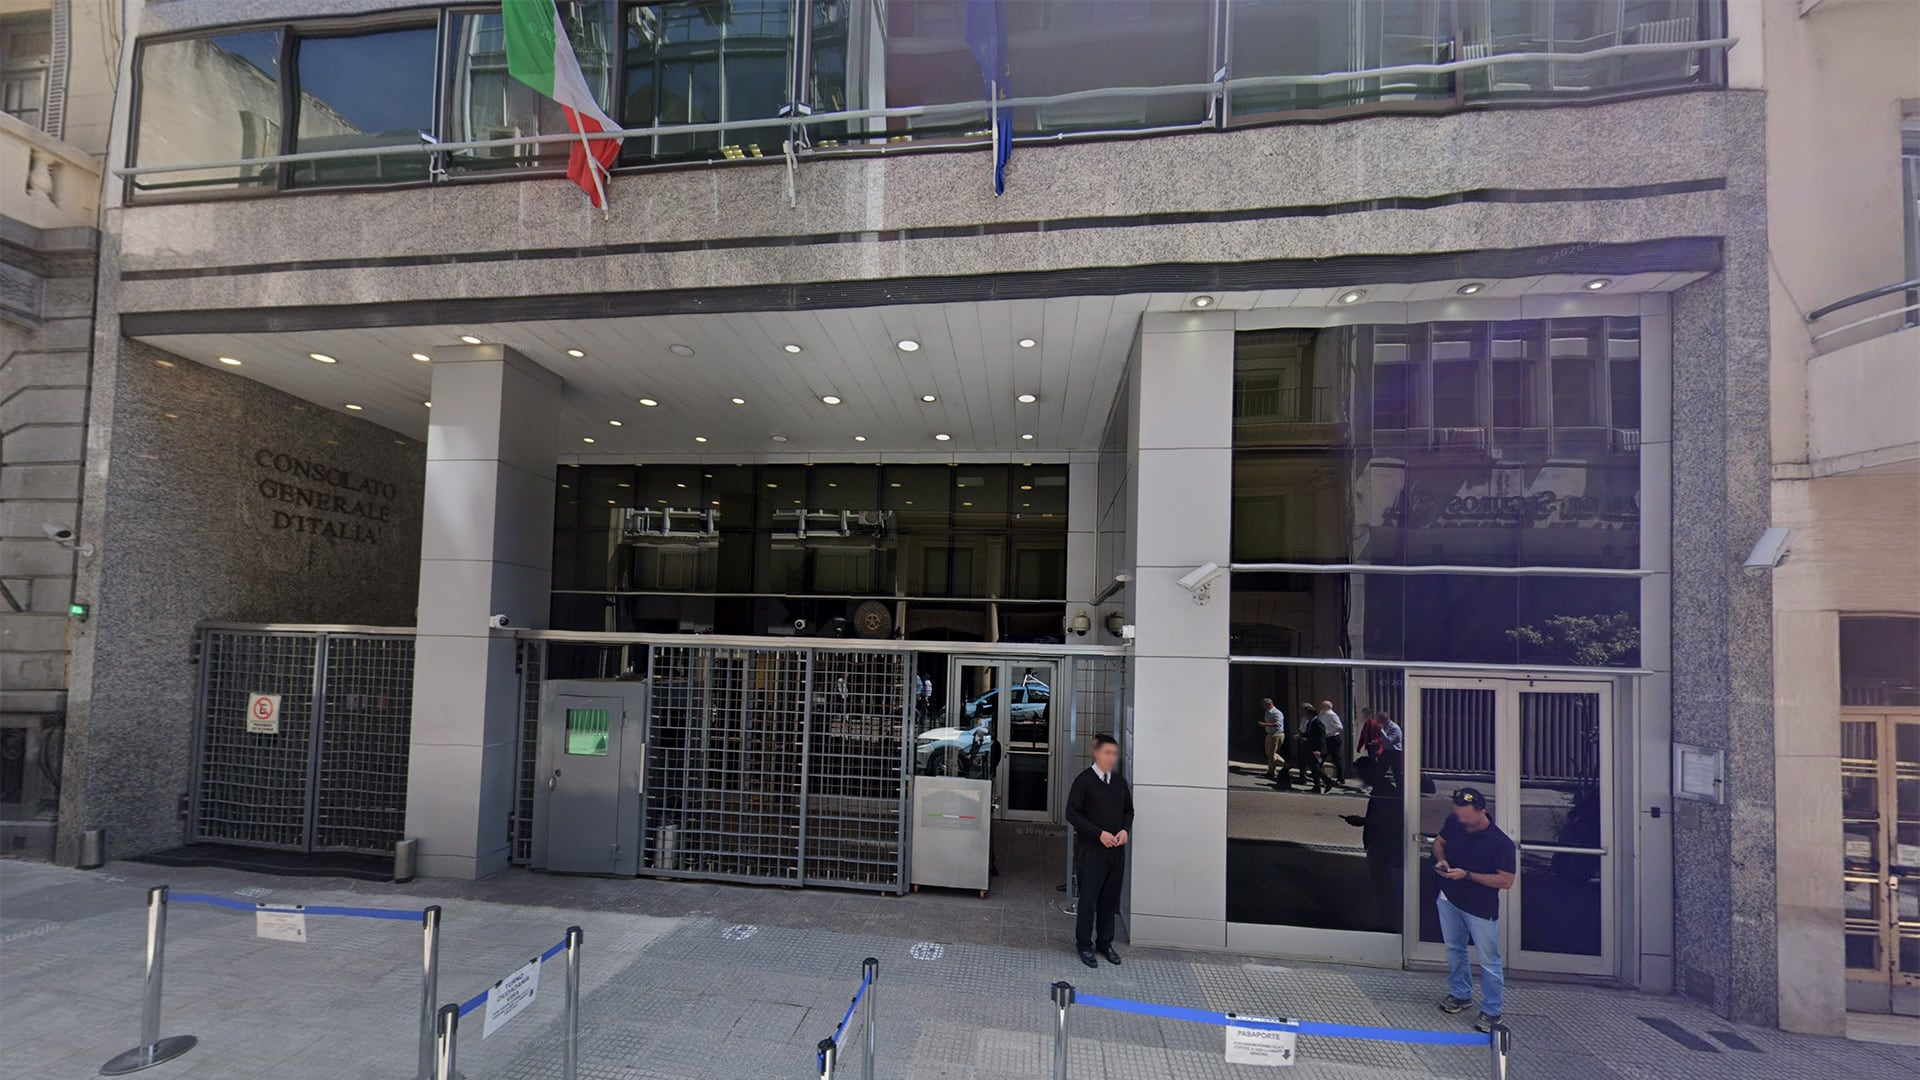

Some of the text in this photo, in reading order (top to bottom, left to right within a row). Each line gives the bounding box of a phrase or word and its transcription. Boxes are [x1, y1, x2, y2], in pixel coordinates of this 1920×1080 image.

[255, 449, 397, 500] CONSOLATO
[258, 478, 391, 523] GENERALE
[1238, 1030, 1281, 1040] PASAPORTE
